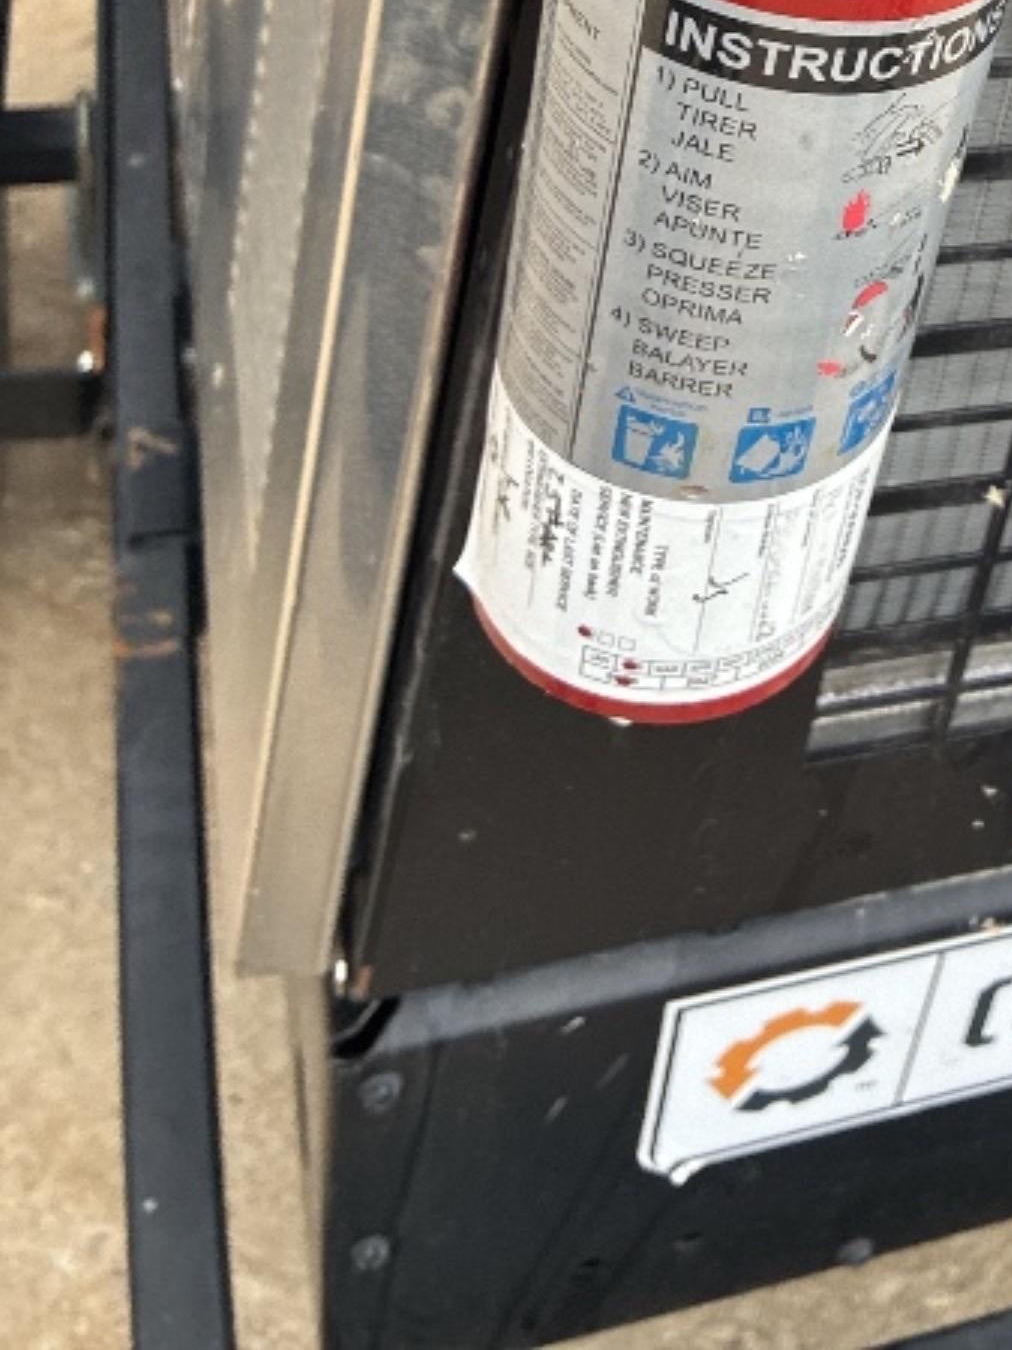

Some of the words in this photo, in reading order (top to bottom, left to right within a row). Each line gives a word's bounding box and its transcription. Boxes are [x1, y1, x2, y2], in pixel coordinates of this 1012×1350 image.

[656, 65, 676, 91] 1)
[682, 77, 750, 112] PULL
[677, 101, 758, 140] TIRER
[671, 132, 736, 163] JALE
[637, 150, 661, 175] 2)
[665, 161, 712, 190] AIM
[661, 186, 741, 223] VISER
[653, 211, 763, 250] APUNTE
[624, 227, 646, 253] 3)
[652, 242, 777, 280] SQUEEZE
[647, 263, 772, 305] PRESSER
[641, 286, 743, 325] OPRIMA
[610, 305, 632, 328] 4)
[637, 317, 730, 352] SWEEP
[632, 338, 748, 377] BALAYER
[628, 359, 734, 399] BARRER
